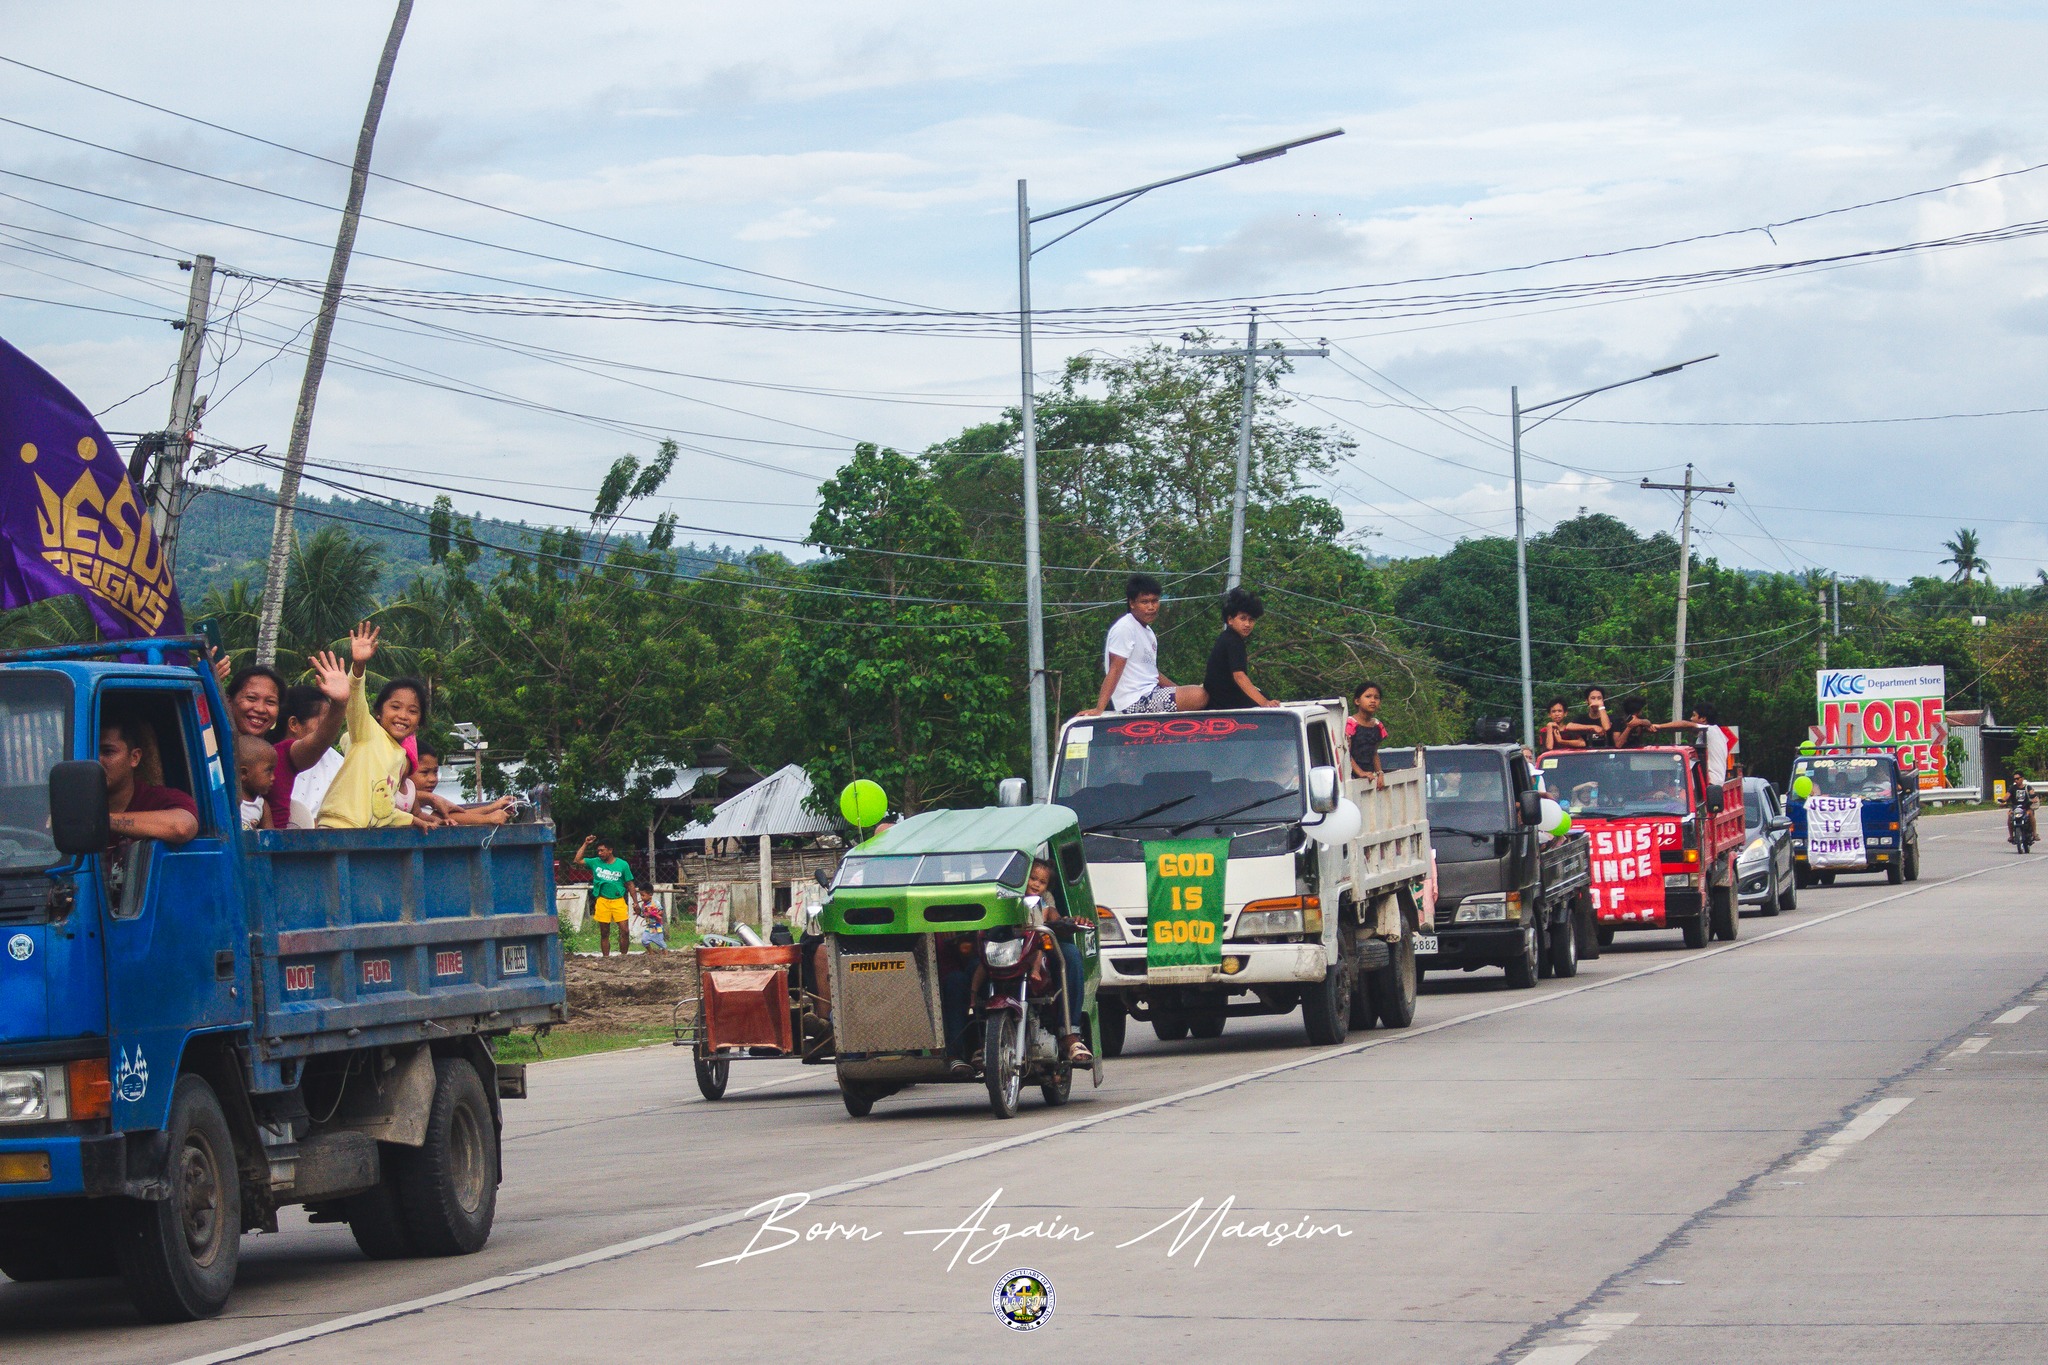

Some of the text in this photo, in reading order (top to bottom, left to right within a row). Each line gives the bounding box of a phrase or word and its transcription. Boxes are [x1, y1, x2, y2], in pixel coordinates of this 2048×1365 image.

[41, 550, 168, 628] REIGNS
[1821, 672, 1942, 697] KCC Department Store
[1120, 718, 1238, 737] GOD
[1810, 798, 1857, 812] JESUS
[1825, 820, 1841, 833] IS
[1583, 826, 1652, 855] SUS
[1811, 837, 1860, 853] COMING
[1158, 852, 1215, 877] GOD
[1592, 853, 1652, 883] INCE
[1171, 886, 1203, 911] IS
[1153, 920, 1216, 944] GOOD
[286, 965, 315, 991] NOT
[363, 959, 392, 985] FOR
[436, 951, 464, 976] HIRE
[849, 960, 906, 972] PRIVATE
